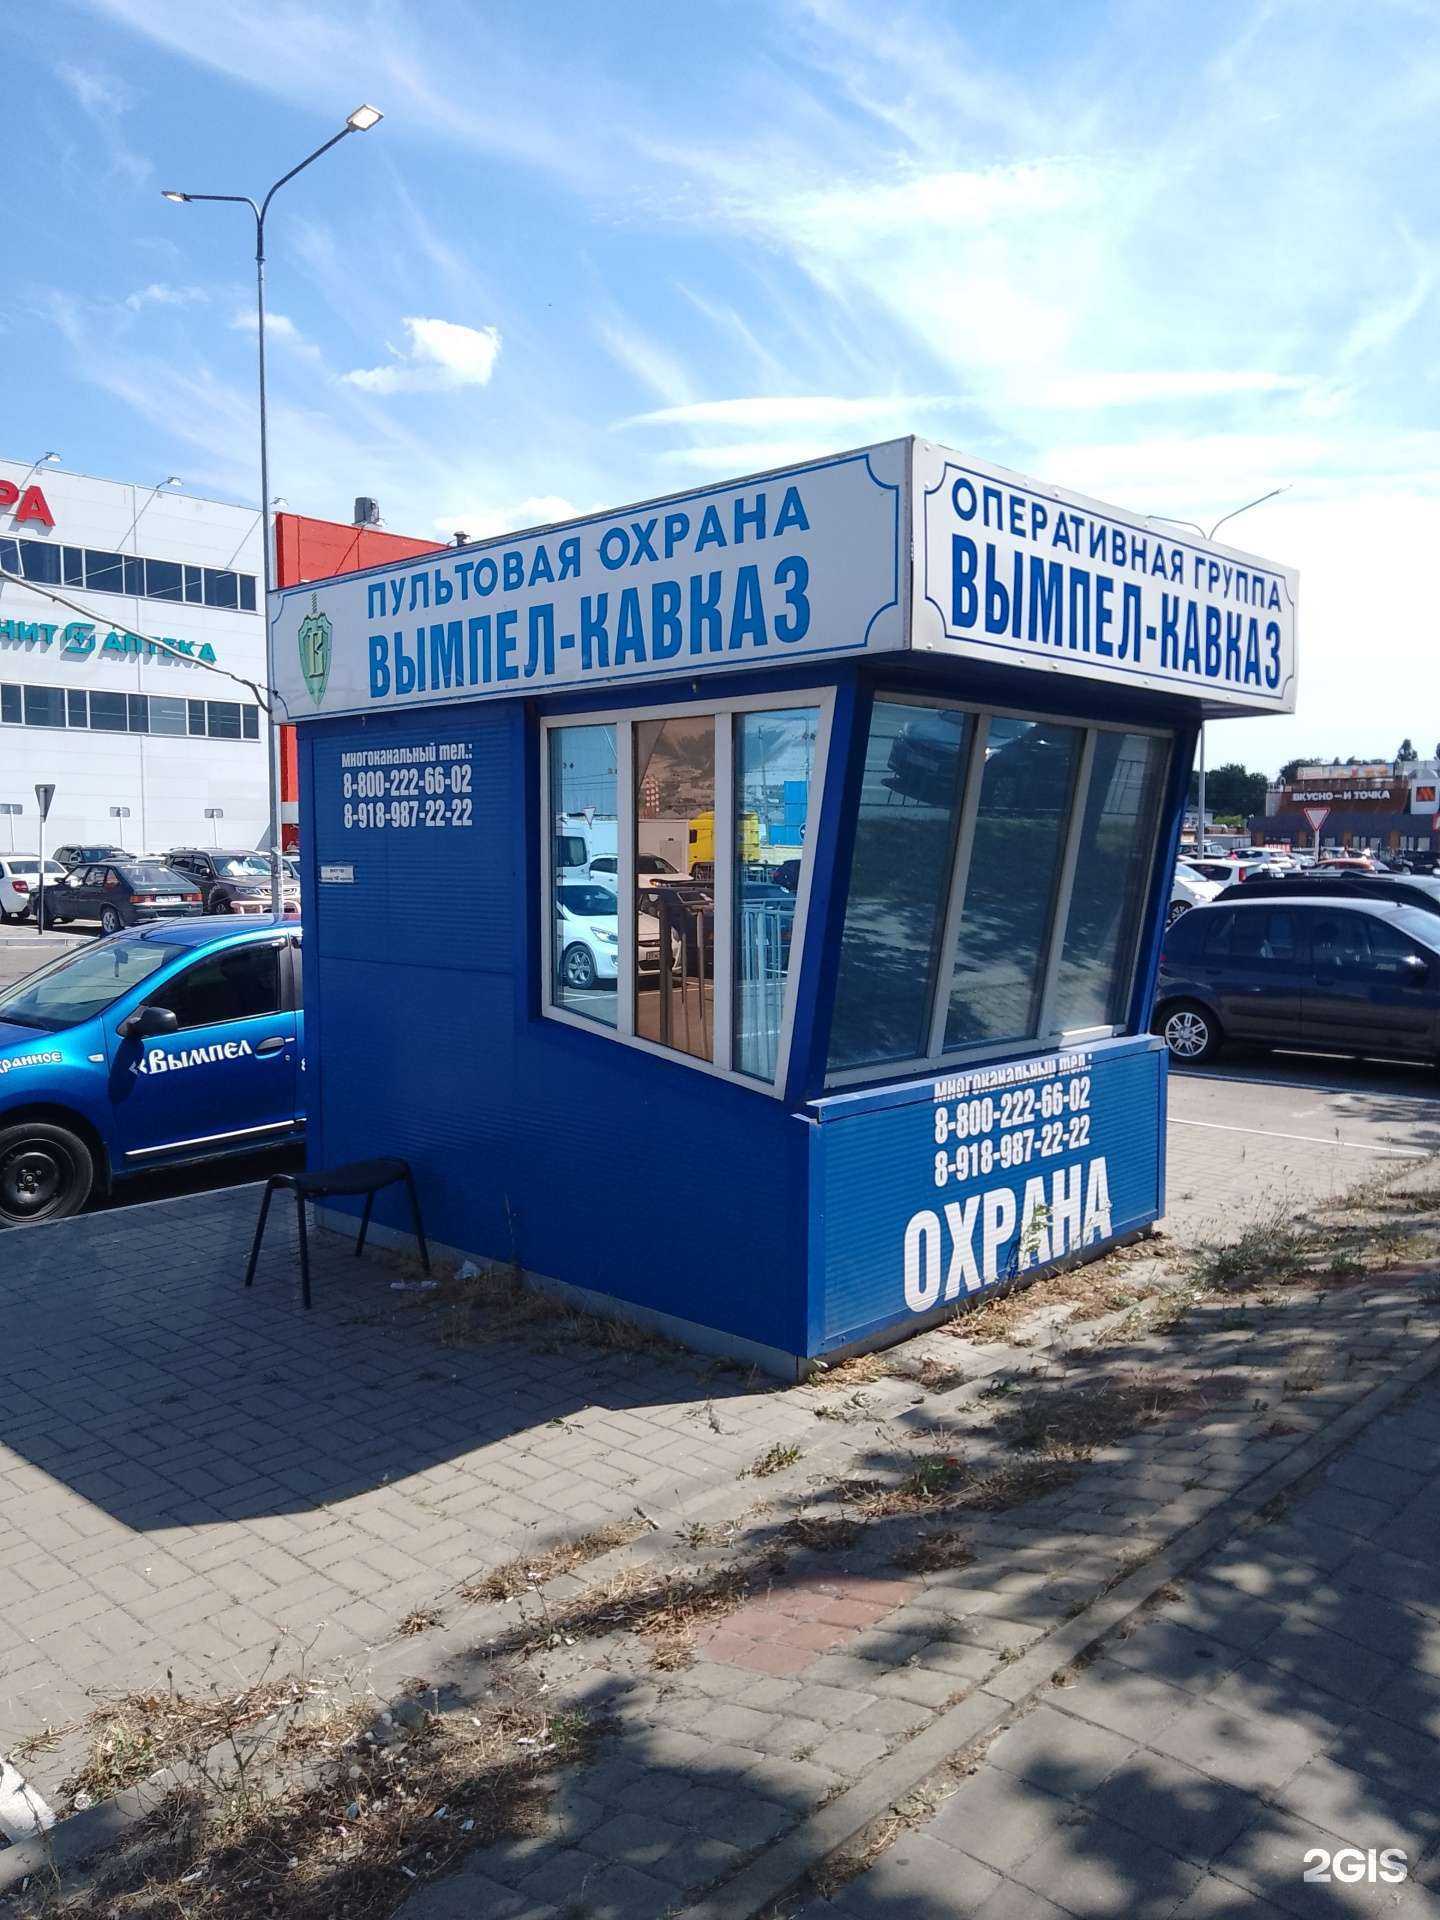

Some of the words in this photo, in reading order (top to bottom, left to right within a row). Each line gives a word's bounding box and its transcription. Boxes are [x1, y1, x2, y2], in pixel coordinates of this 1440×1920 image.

[367, 537, 581, 619] ПУЛЬТОВАЯ
[600, 486, 811, 570] ОХРАНА
[952, 477, 1184, 585] ОПЕРАТИВНАЯ
[1194, 557, 1283, 613] ГРУППА
[368, 555, 811, 699] ВЫМПЕЛ-КАВКАЗ
[952, 533, 1282, 690] ВЫМПЕЛ-КАВКАЗ
[342, 742, 436, 767] многоканальный
[343, 764, 473, 799] 8-800-222-66-02
[344, 798, 473, 829] 8-918-987-22-22
[1293, 792, 1333, 801] ВКУСНО
[1354, 790, 1390, 800] ТОЧКА
[0, 1052, 62, 1073] ранное
[934, 1076, 1091, 1144] 8-800-222-66-02
[934, 1114, 1091, 1187] 8-918-987-22-22
[904, 1157, 1112, 1312] ОХРАНА
